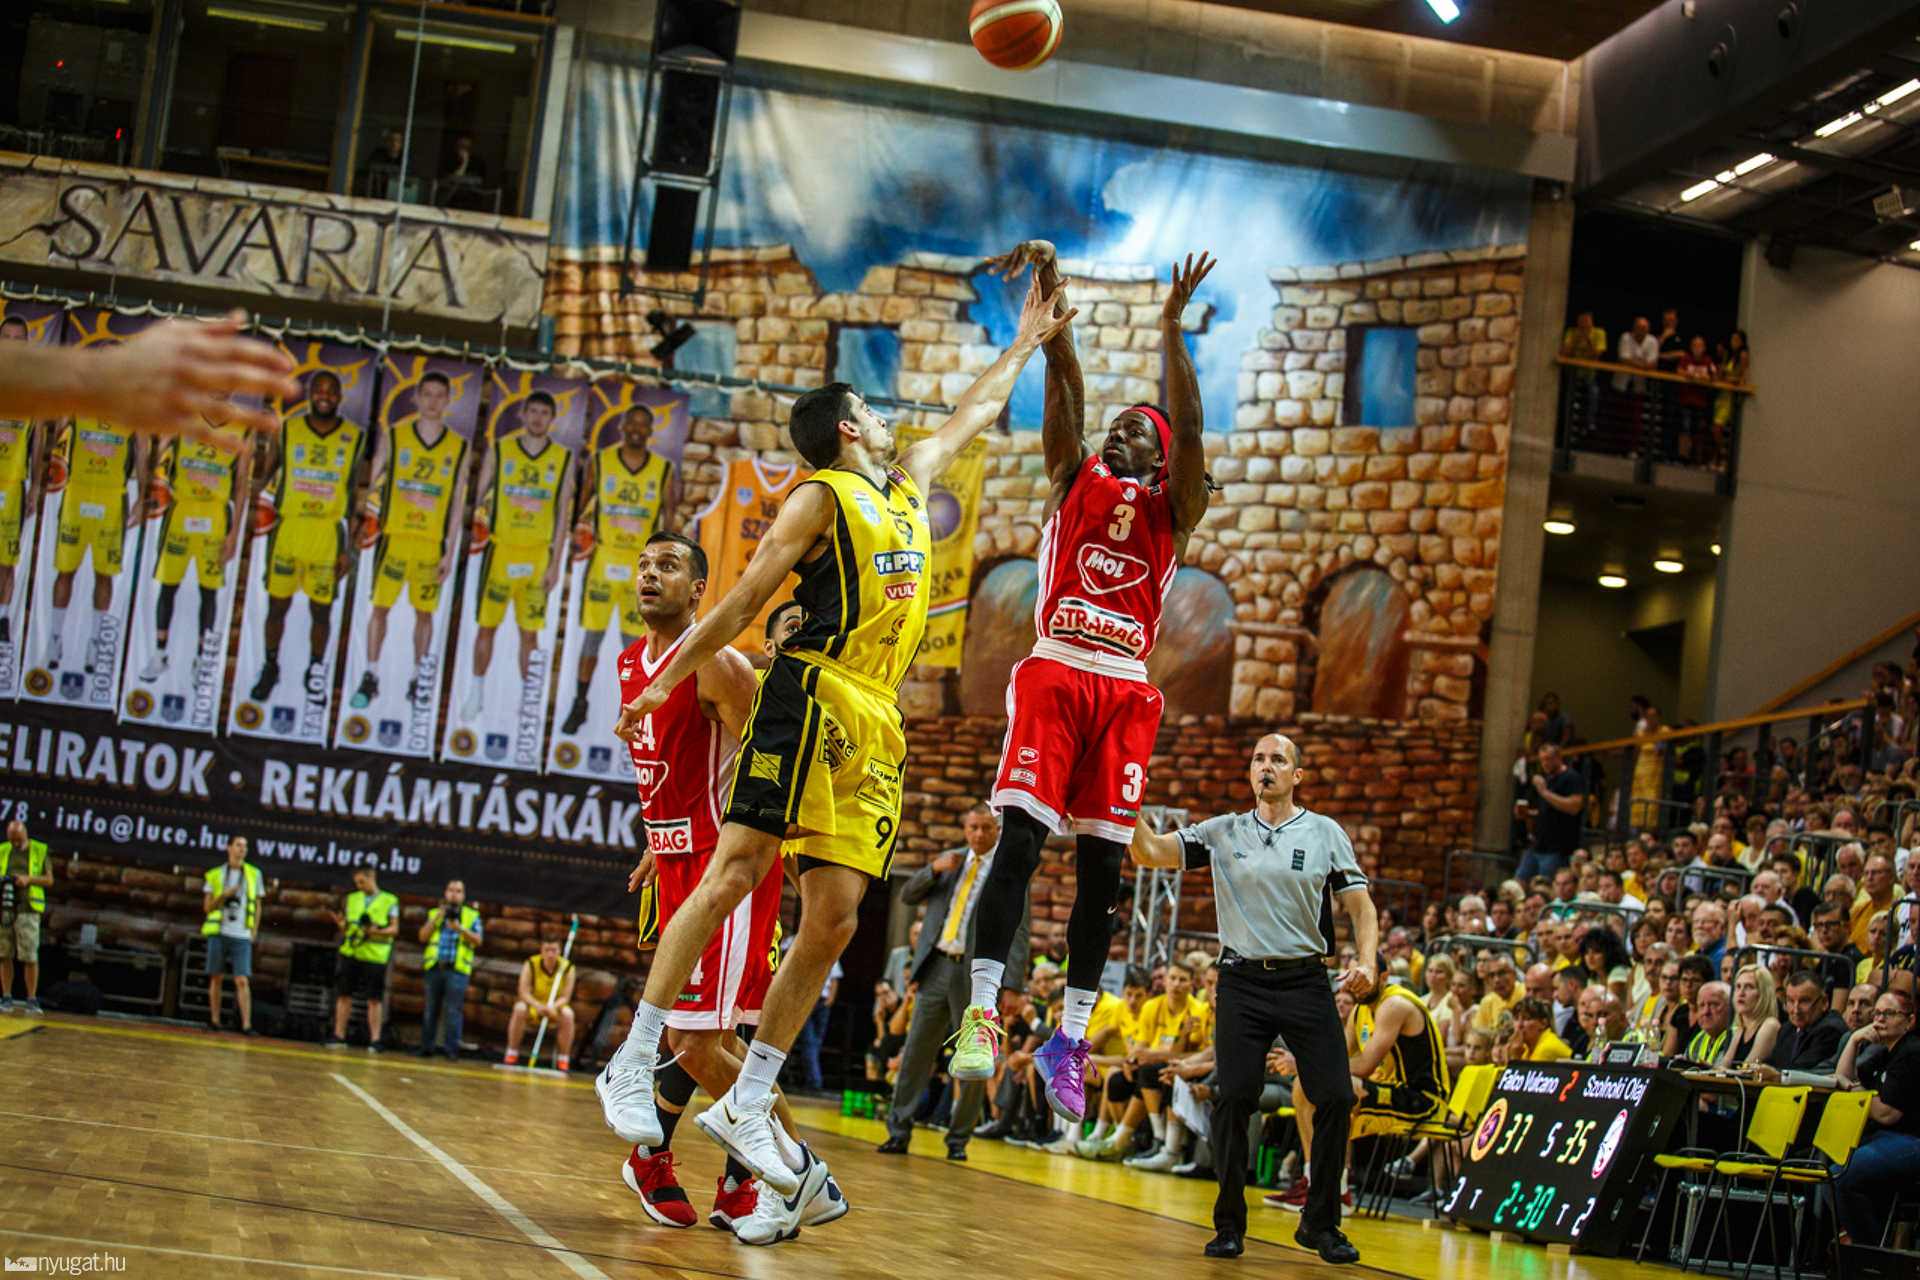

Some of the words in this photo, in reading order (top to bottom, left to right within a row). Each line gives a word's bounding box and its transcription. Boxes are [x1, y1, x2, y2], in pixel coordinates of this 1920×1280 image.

[49, 184, 463, 308] SAVARIA
[893, 518, 914, 545] 9
[1107, 503, 1135, 542] 3
[1085, 550, 1126, 579] MOL
[1053, 607, 1144, 648] STRABAG
[301, 661, 330, 737] TAYLOR
[1121, 762, 1144, 802] 3
[259, 758, 642, 849] REKLÁMTÁSKÁK
[55, 806, 230, 851] info@luce.hu
[256, 838, 422, 875] www.luce.hu
[875, 816, 893, 849] 9
[1497, 1068, 1525, 1091] Falco
[1522, 1069, 1561, 1094] Vulcano
[1558, 1070, 1580, 1103] 2
[1582, 1073, 1630, 1099] Szolnoki
[1623, 1077, 1650, 1107] Olaj
[1556, 1118, 1597, 1165] 35
[1443, 1175, 1467, 1213] 3
[1469, 1188, 1483, 1210] T
[1493, 1180, 1557, 1231] 2:30
[1555, 1202, 1571, 1227] T
[1570, 1196, 1597, 1237] 2
